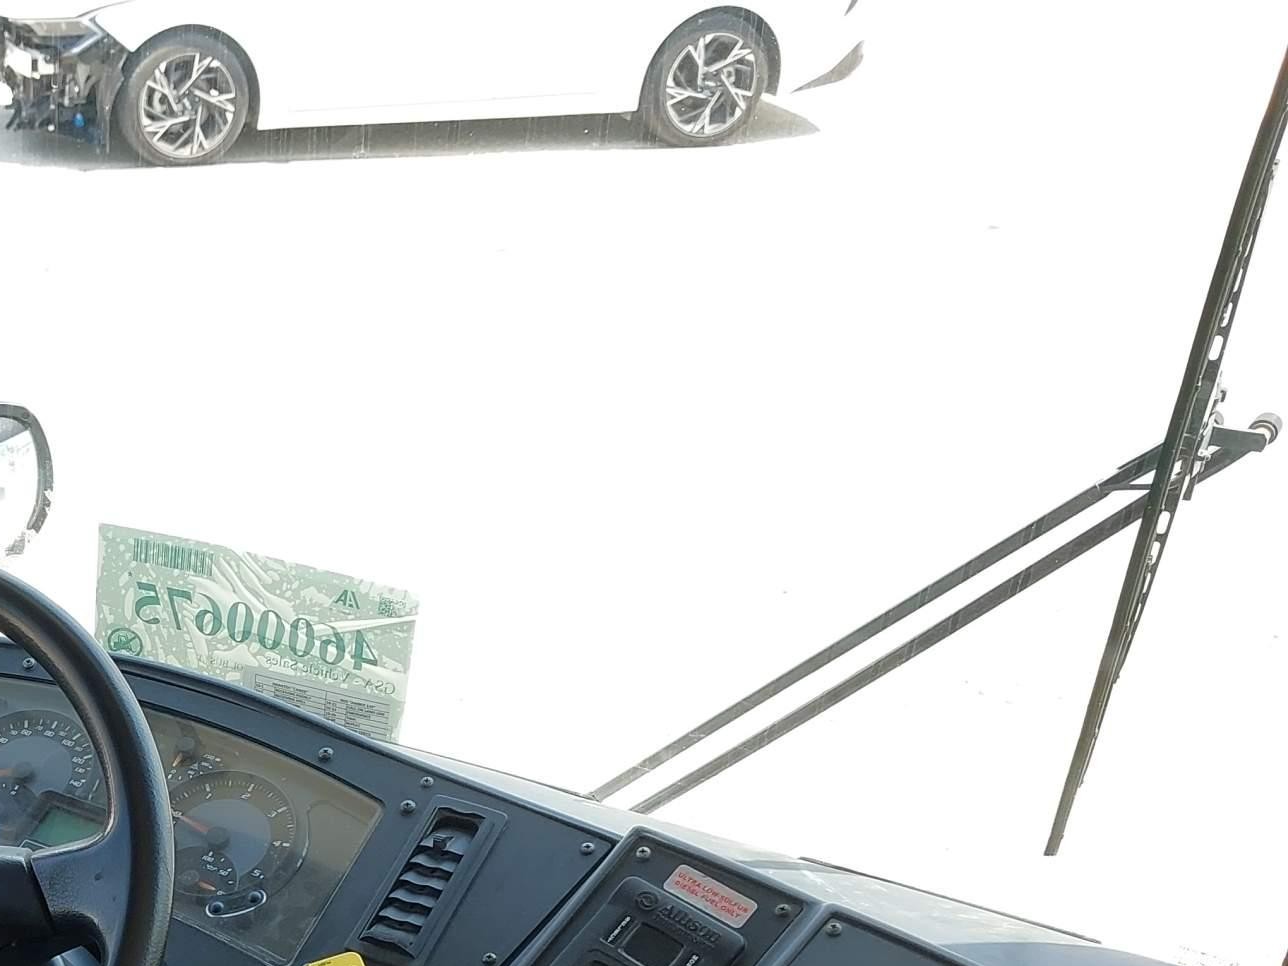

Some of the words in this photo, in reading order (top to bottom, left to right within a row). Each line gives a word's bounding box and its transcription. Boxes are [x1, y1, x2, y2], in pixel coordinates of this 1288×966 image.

[72, 756, 85, 764] 120
[69, 780, 83, 788] 140
[678, 872, 703, 890] ULTRA
[702, 884, 719, 900] LOW
[674, 879, 699, 898] DIESEL
[700, 893, 719, 908] FUEL
[720, 905, 741, 919] ONLY
